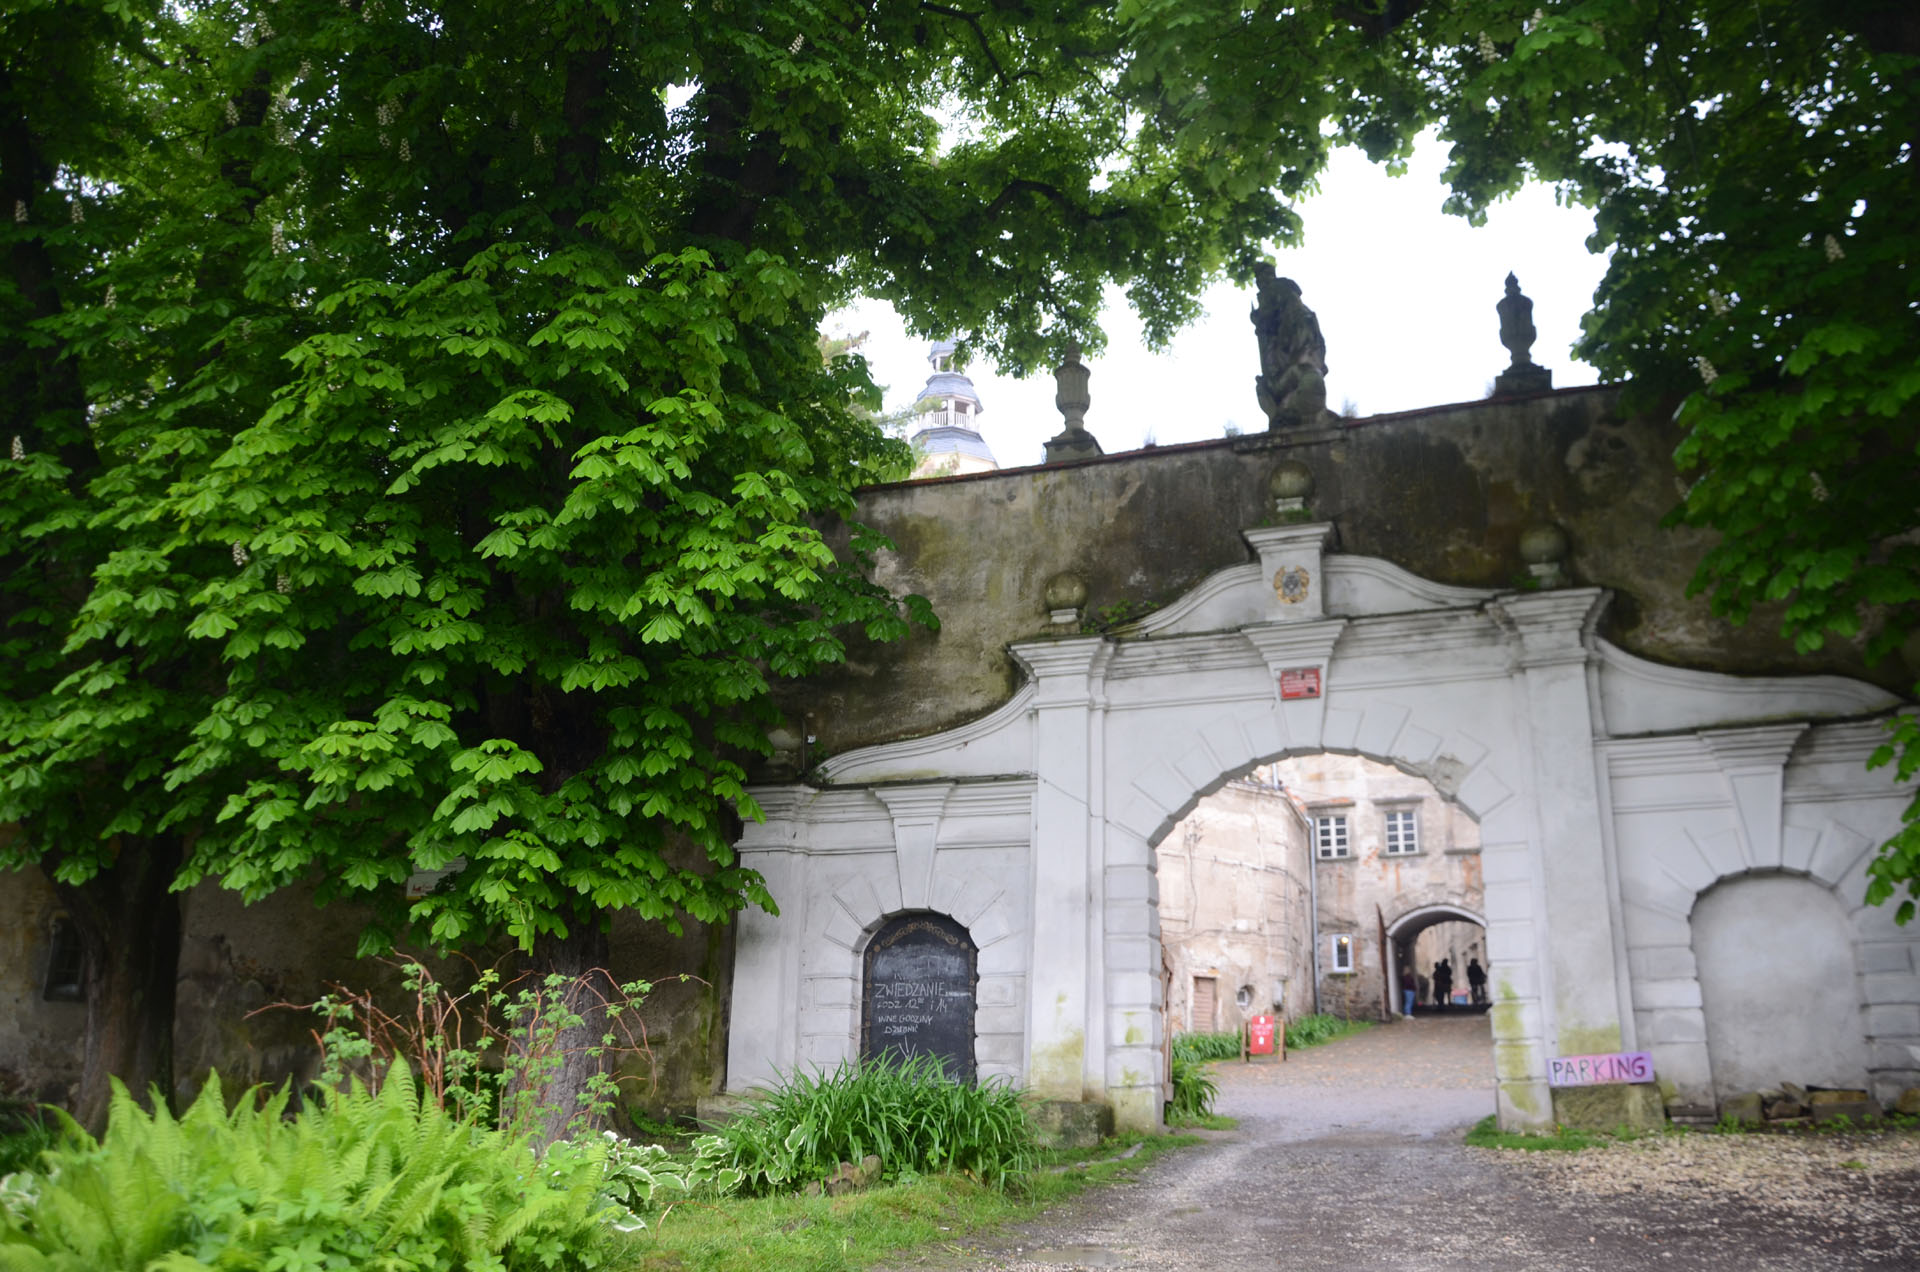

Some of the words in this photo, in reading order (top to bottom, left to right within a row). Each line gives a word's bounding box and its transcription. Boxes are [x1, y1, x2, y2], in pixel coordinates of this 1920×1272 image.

[874, 981, 946, 998] ZWIEDZANIE
[878, 1015, 897, 1024] INNE
[899, 1014, 934, 1025] GODZINY
[1552, 1056, 1646, 1082] PARKING
